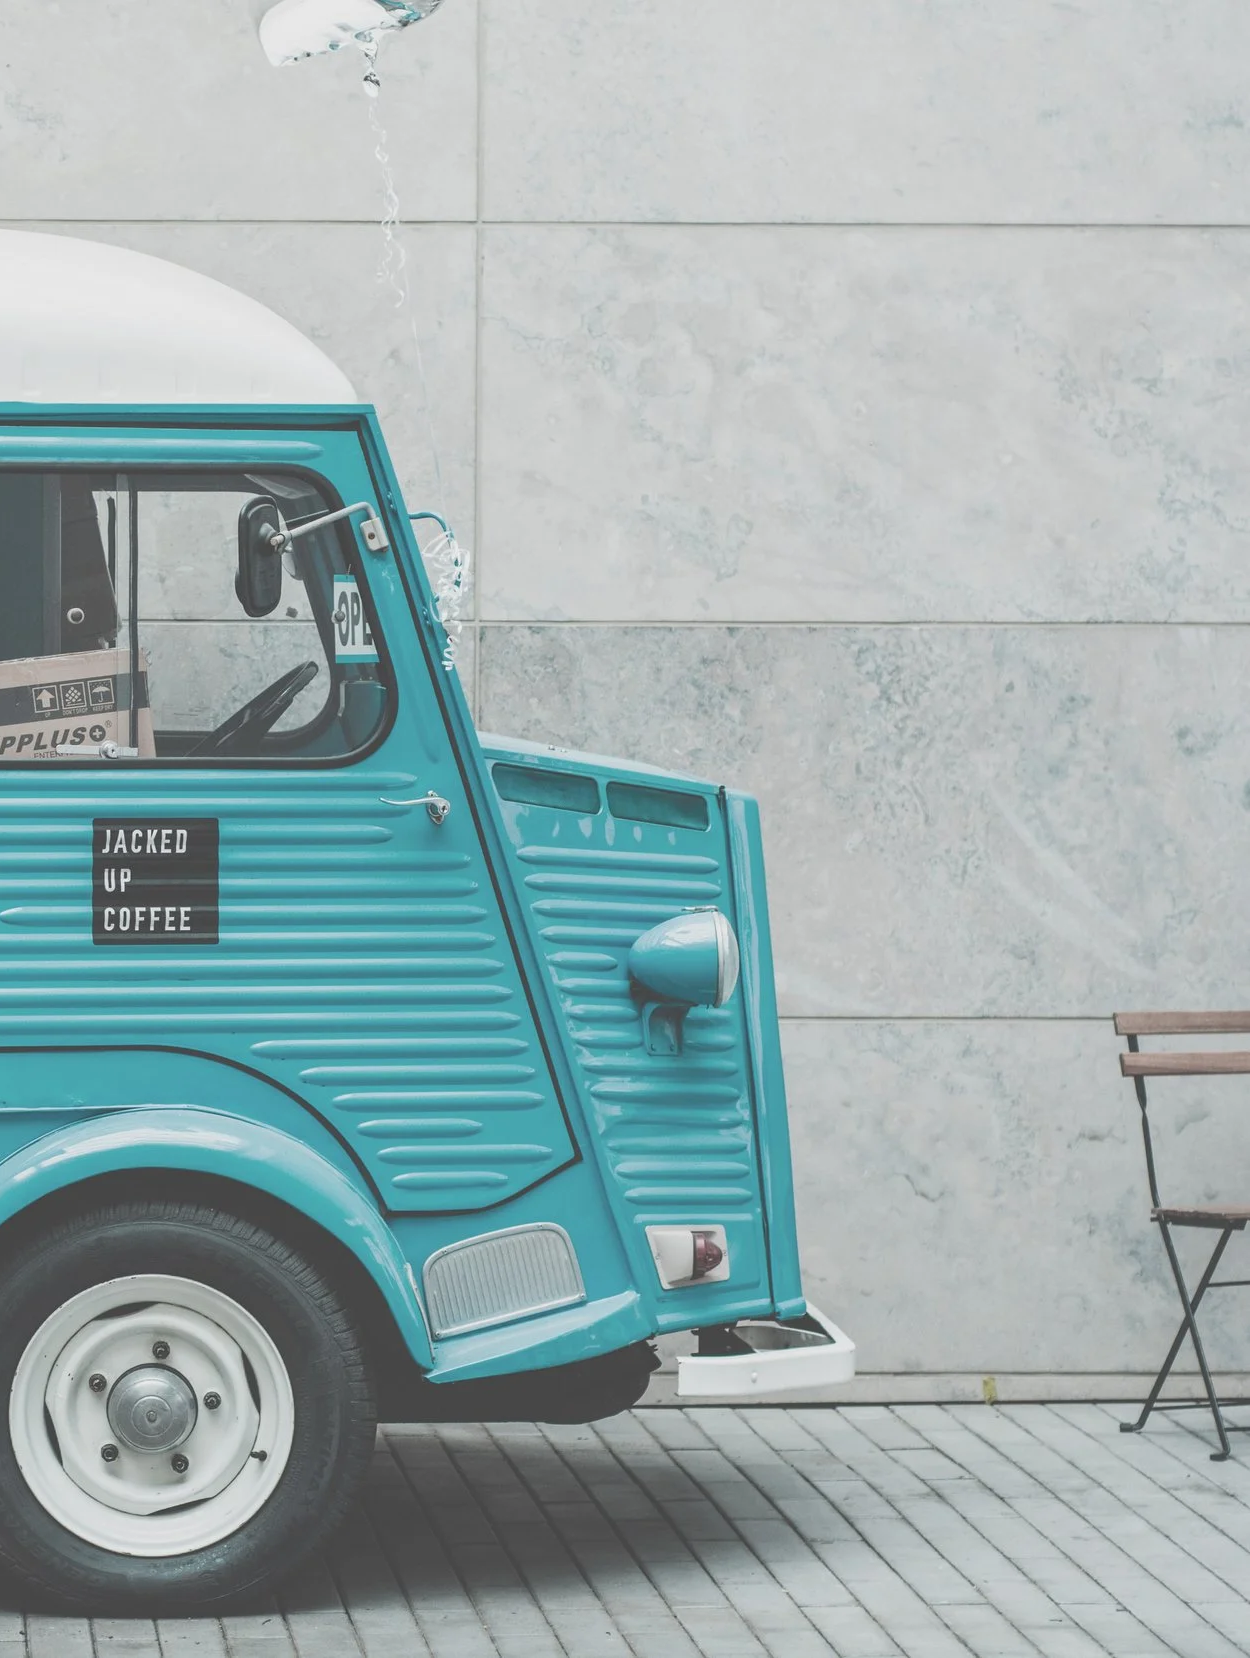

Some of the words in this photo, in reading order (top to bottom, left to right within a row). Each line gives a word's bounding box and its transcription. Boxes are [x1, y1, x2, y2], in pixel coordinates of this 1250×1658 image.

[102, 830, 187, 853] JACKED
[104, 869, 131, 892] UP
[104, 907, 191, 931] COFFEE
